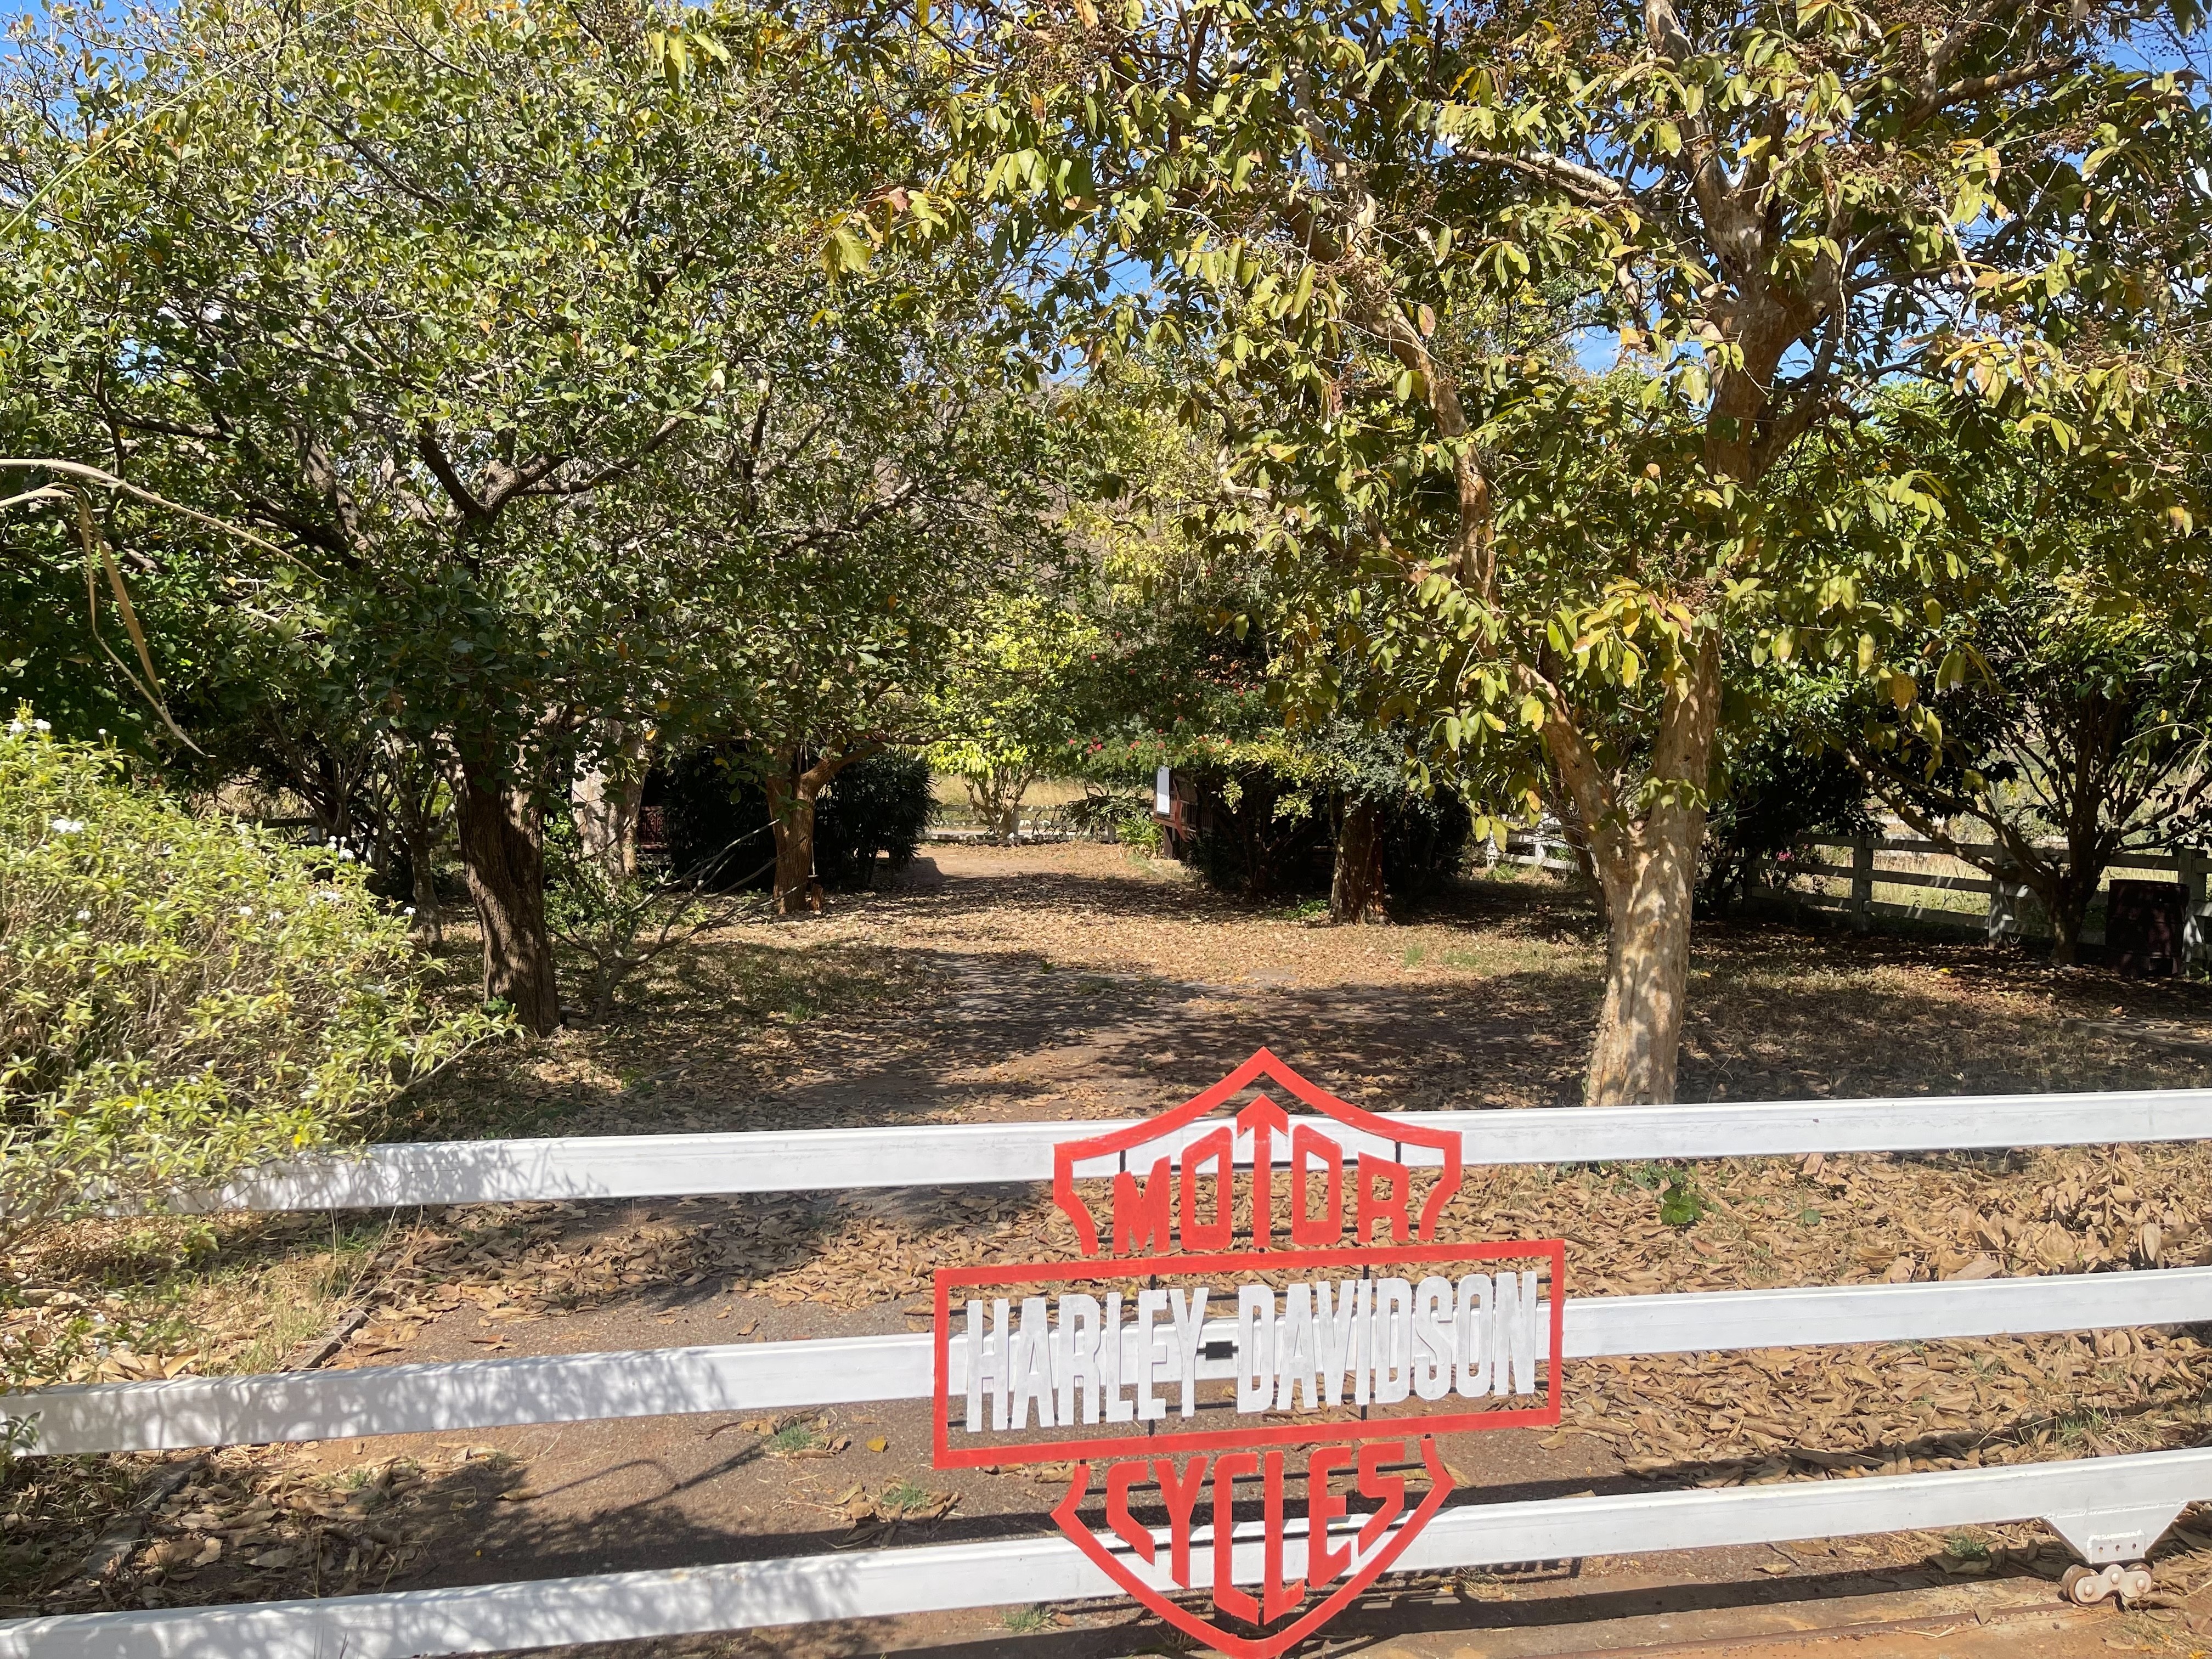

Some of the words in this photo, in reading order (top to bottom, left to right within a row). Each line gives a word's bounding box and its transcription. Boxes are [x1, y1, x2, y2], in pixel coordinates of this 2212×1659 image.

[1113, 1093, 1409, 1253] MOTOR
[966, 1271, 1537, 1433] HARLEY-DAVIDSON
[1107, 1441, 1405, 1626] CYCLES
